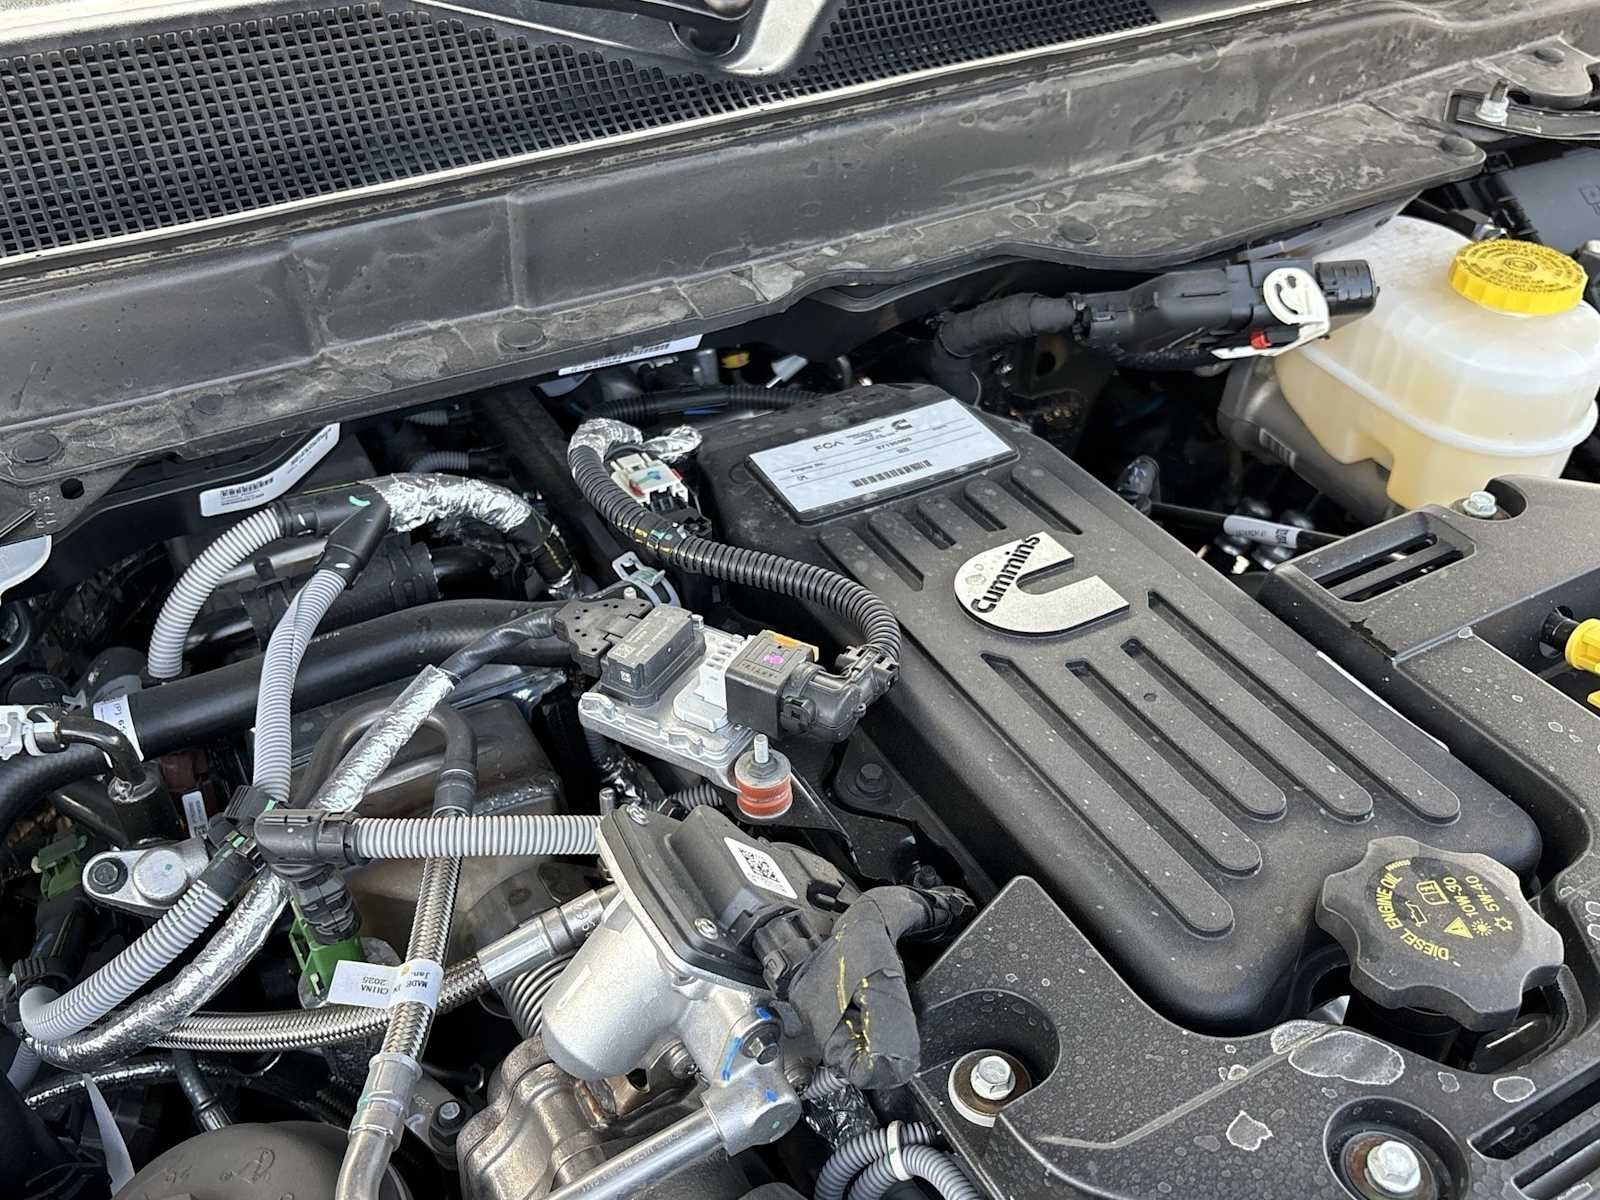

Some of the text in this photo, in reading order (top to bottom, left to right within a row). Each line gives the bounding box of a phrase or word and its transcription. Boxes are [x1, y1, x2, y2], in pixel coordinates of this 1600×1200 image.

[970, 536, 1040, 613] Cummins
[1380, 873, 1403, 889] OIL
[1442, 876, 1479, 918] 10W-30
[1464, 875, 1500, 912] 5W-40
[1376, 887, 1403, 930] ENGINE
[1400, 928, 1449, 960] DIESEL
[361, 984, 389, 995] CHINA
[363, 976, 387, 986] 2025
[406, 980, 428, 988] MADE
